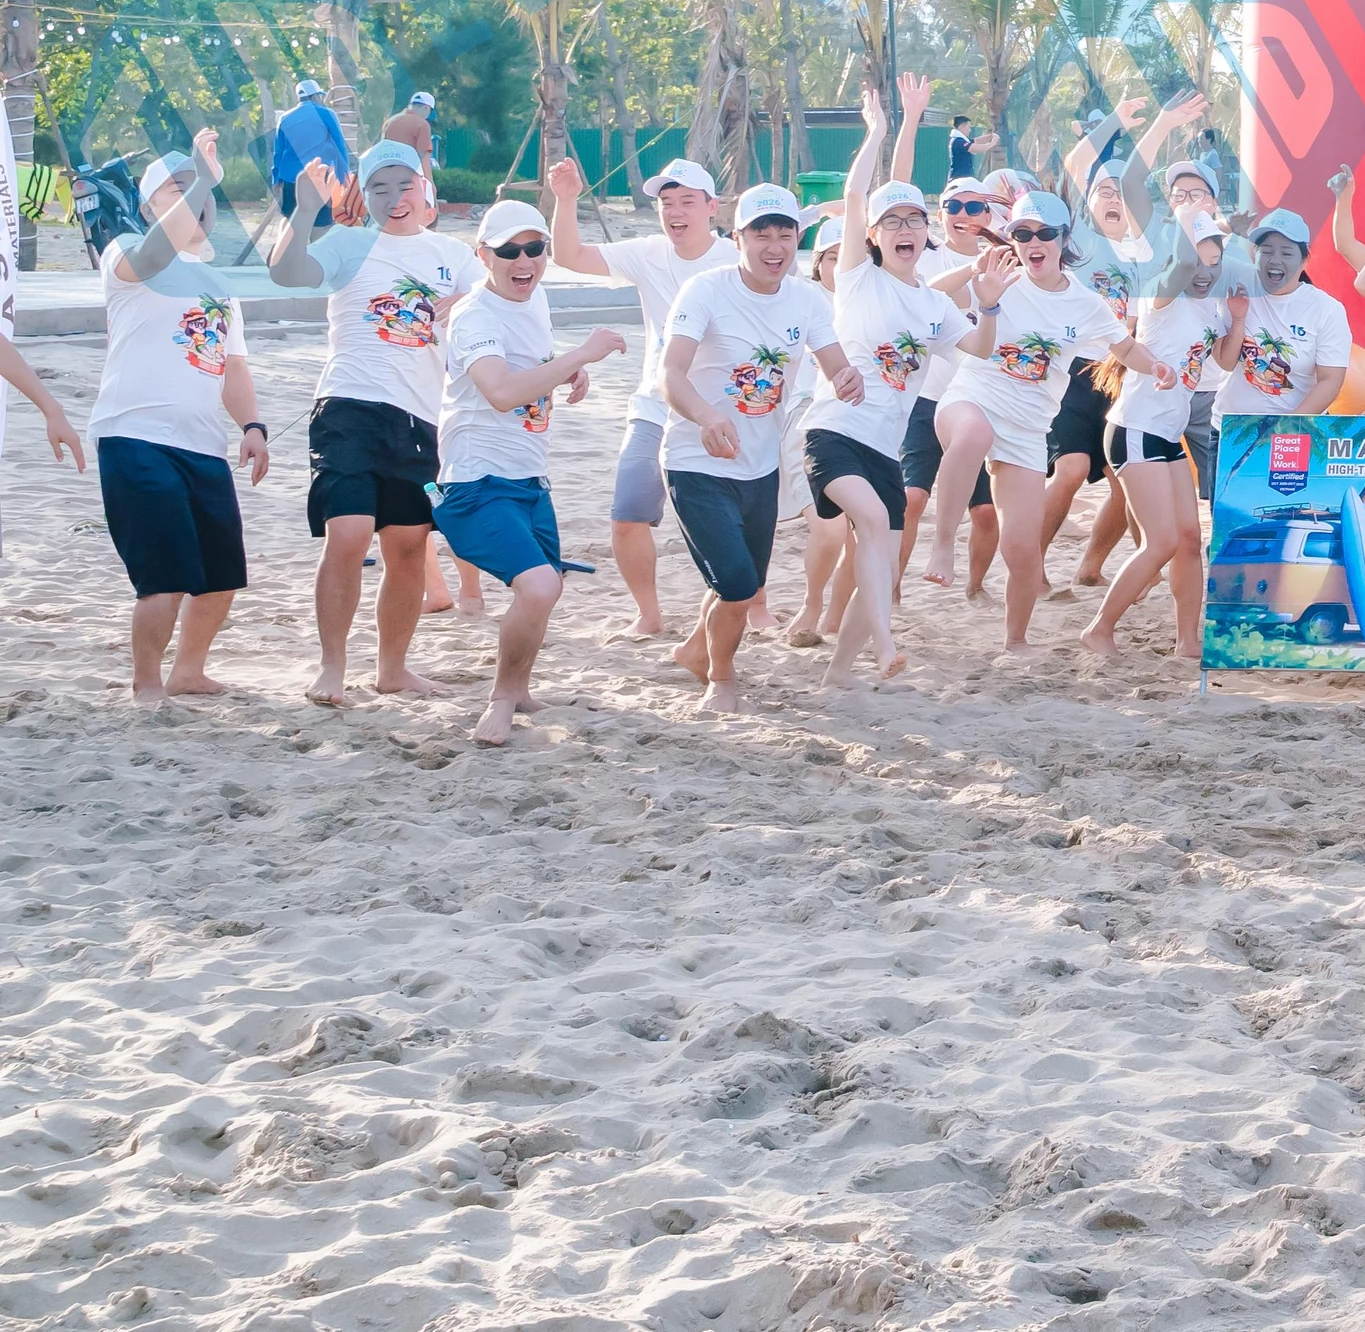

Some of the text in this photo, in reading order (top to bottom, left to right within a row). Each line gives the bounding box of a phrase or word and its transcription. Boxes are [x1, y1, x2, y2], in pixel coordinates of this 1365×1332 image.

[886, 193, 909, 202] 2026
[757, 199, 781, 207] 2026
[1022, 205, 1041, 213] 2026
[786, 326, 800, 341] 16
[1064, 326, 1076, 338] 16
[1290, 325, 1306, 337] 16
[1274, 437, 1301, 445] Great
[1274, 445, 1300, 453] Place
[1272, 472, 1305, 480] Certified
